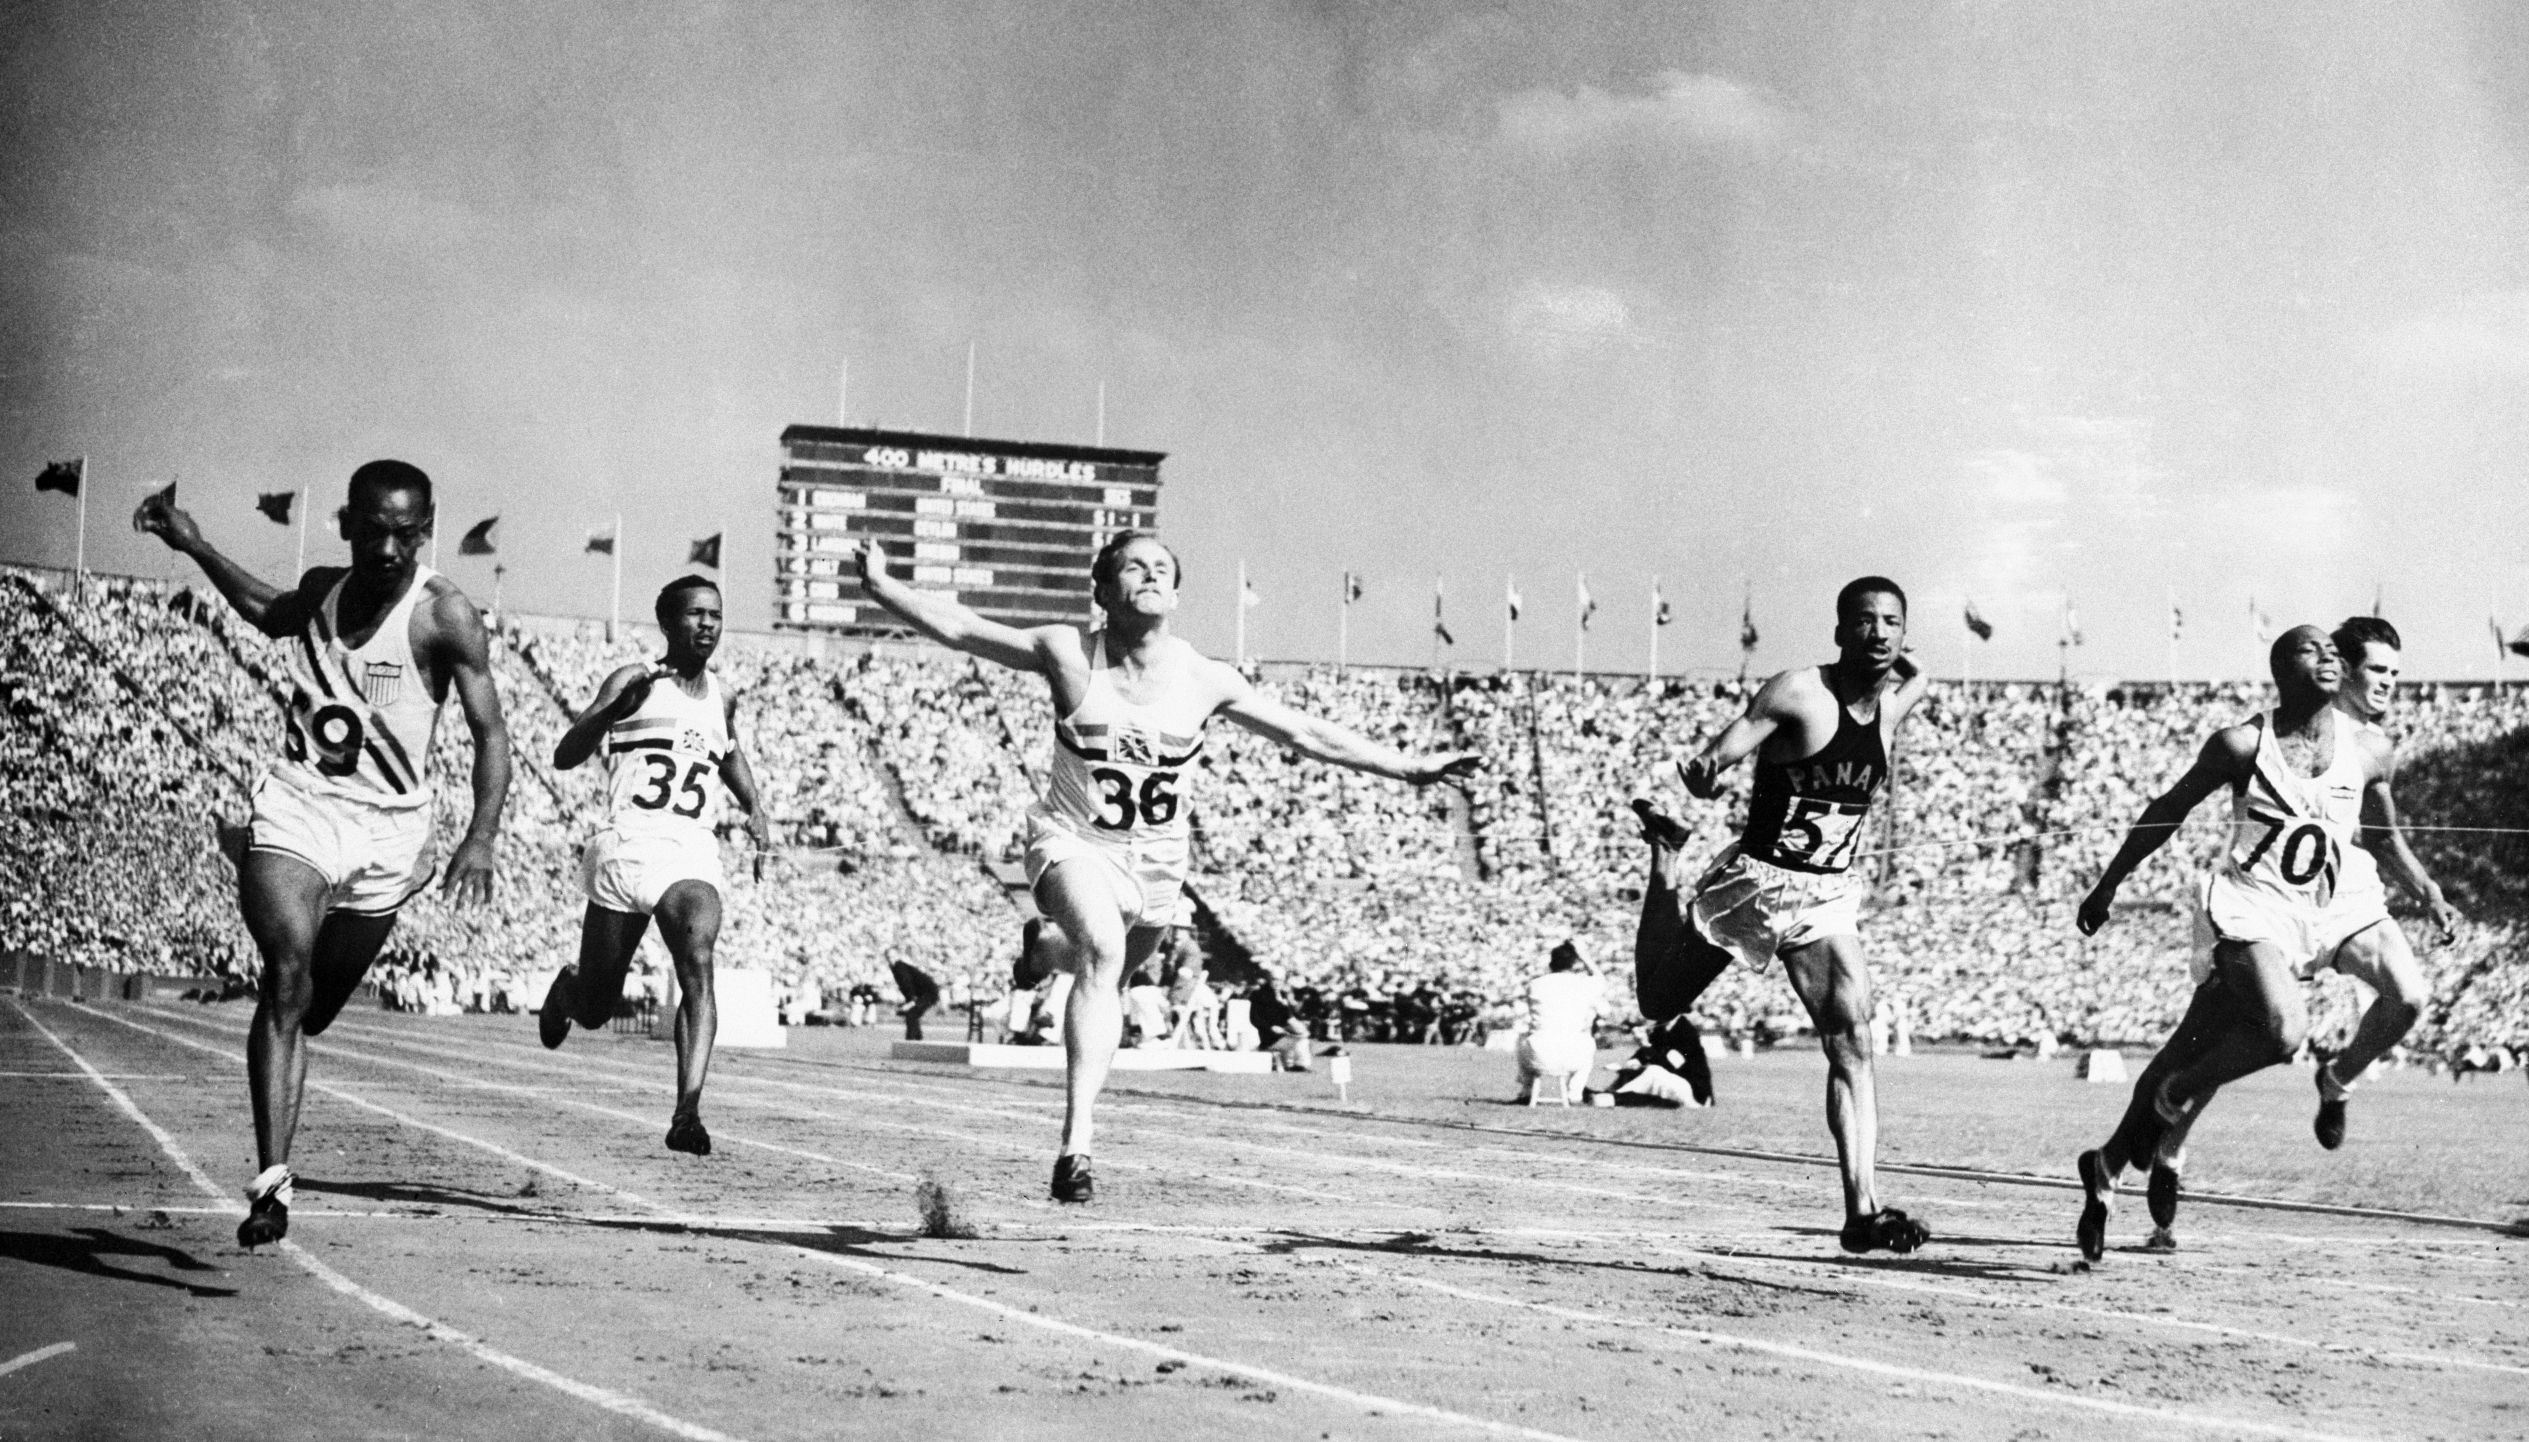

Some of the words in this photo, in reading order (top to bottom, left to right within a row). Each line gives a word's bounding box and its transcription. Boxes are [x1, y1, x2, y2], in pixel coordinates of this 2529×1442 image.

[864, 447, 909, 468] 400
[1006, 456, 1095, 481] HURDLES
[941, 476, 985, 496] FINAL
[632, 754, 711, 819] 35
[1092, 768, 1179, 831] 36
[1786, 761, 1883, 795] PANA
[2241, 807, 2327, 885] 70
